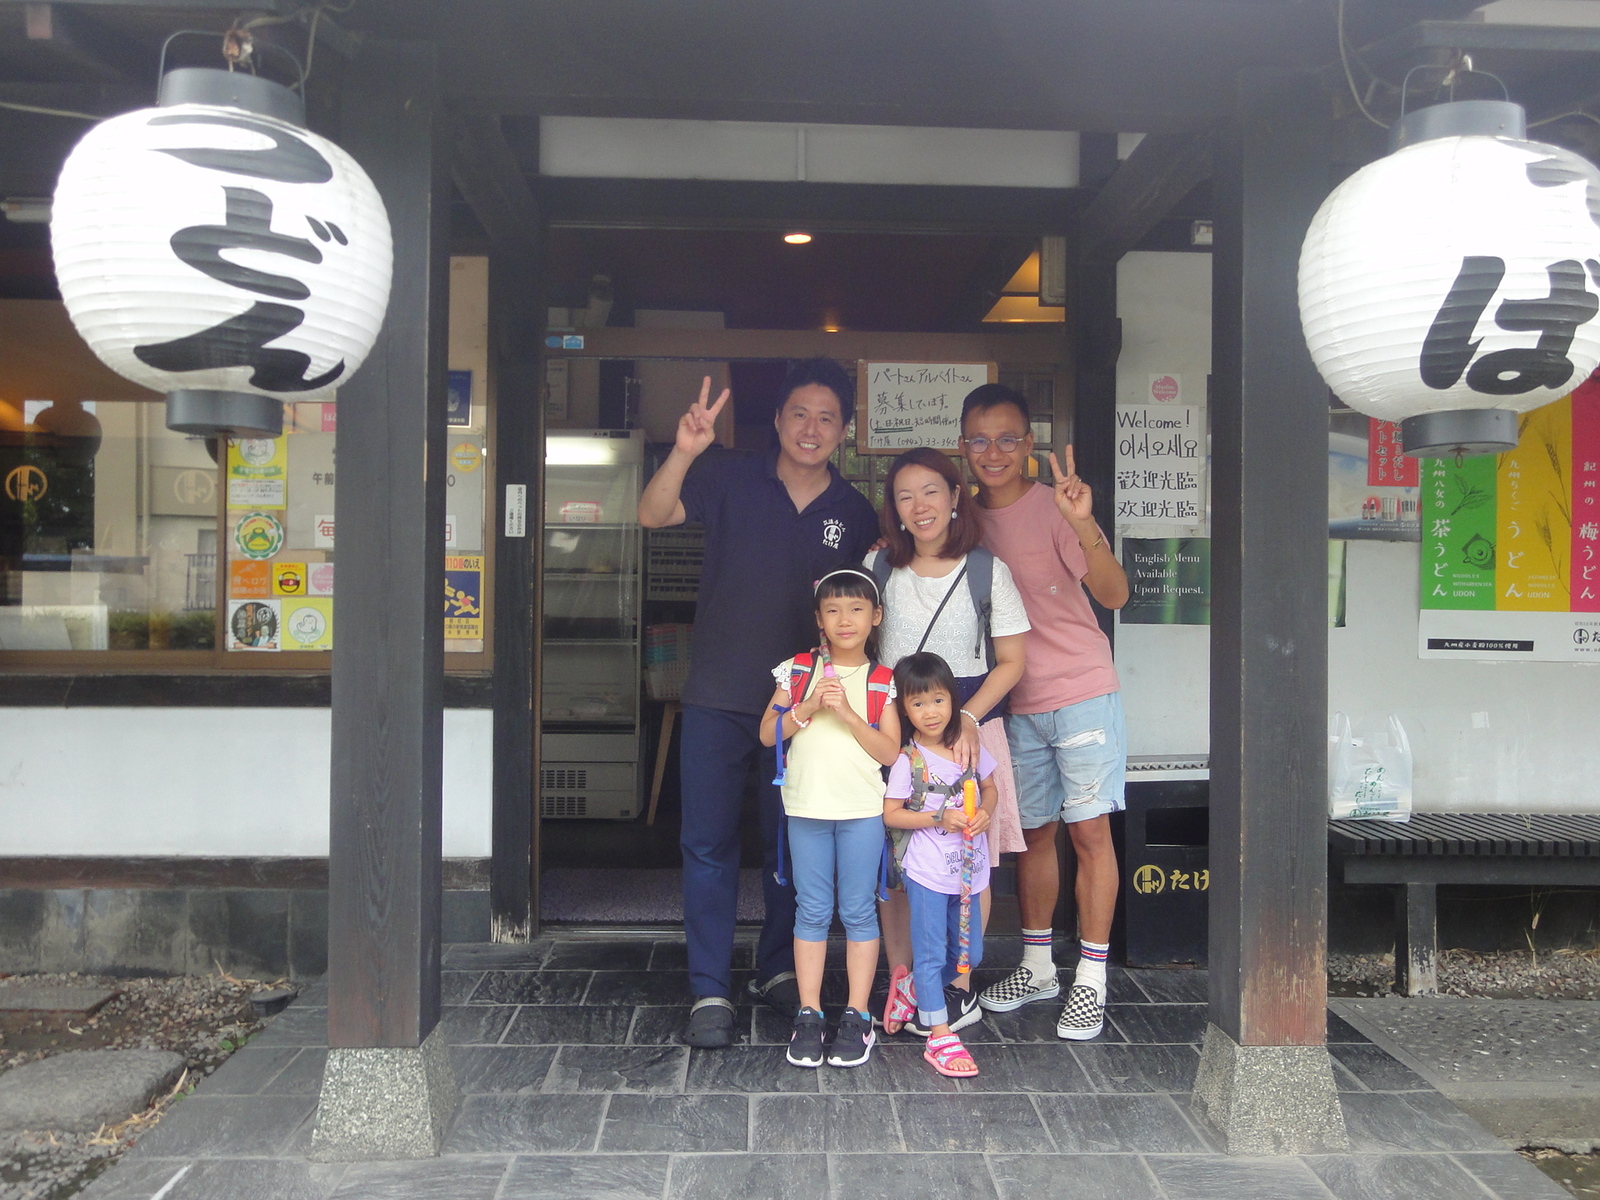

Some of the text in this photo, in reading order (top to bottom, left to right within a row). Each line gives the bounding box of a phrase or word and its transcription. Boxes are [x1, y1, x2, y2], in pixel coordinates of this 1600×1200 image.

[134, 109, 348, 392] うどん
[1119, 433, 1198, 459] 어서오세요
[312, 472, 333, 486] 午前
[1134, 553, 1200, 565] English Menu
[1430, 518, 1451, 597] 茶うどん
[1505, 521, 1525, 598] うどん
[1578, 522, 1599, 599] 梅うどん
[1134, 568, 1178, 579] Available
[1134, 584, 1204, 596] Upon Request.
[1170, 869, 1210, 891] たけ
